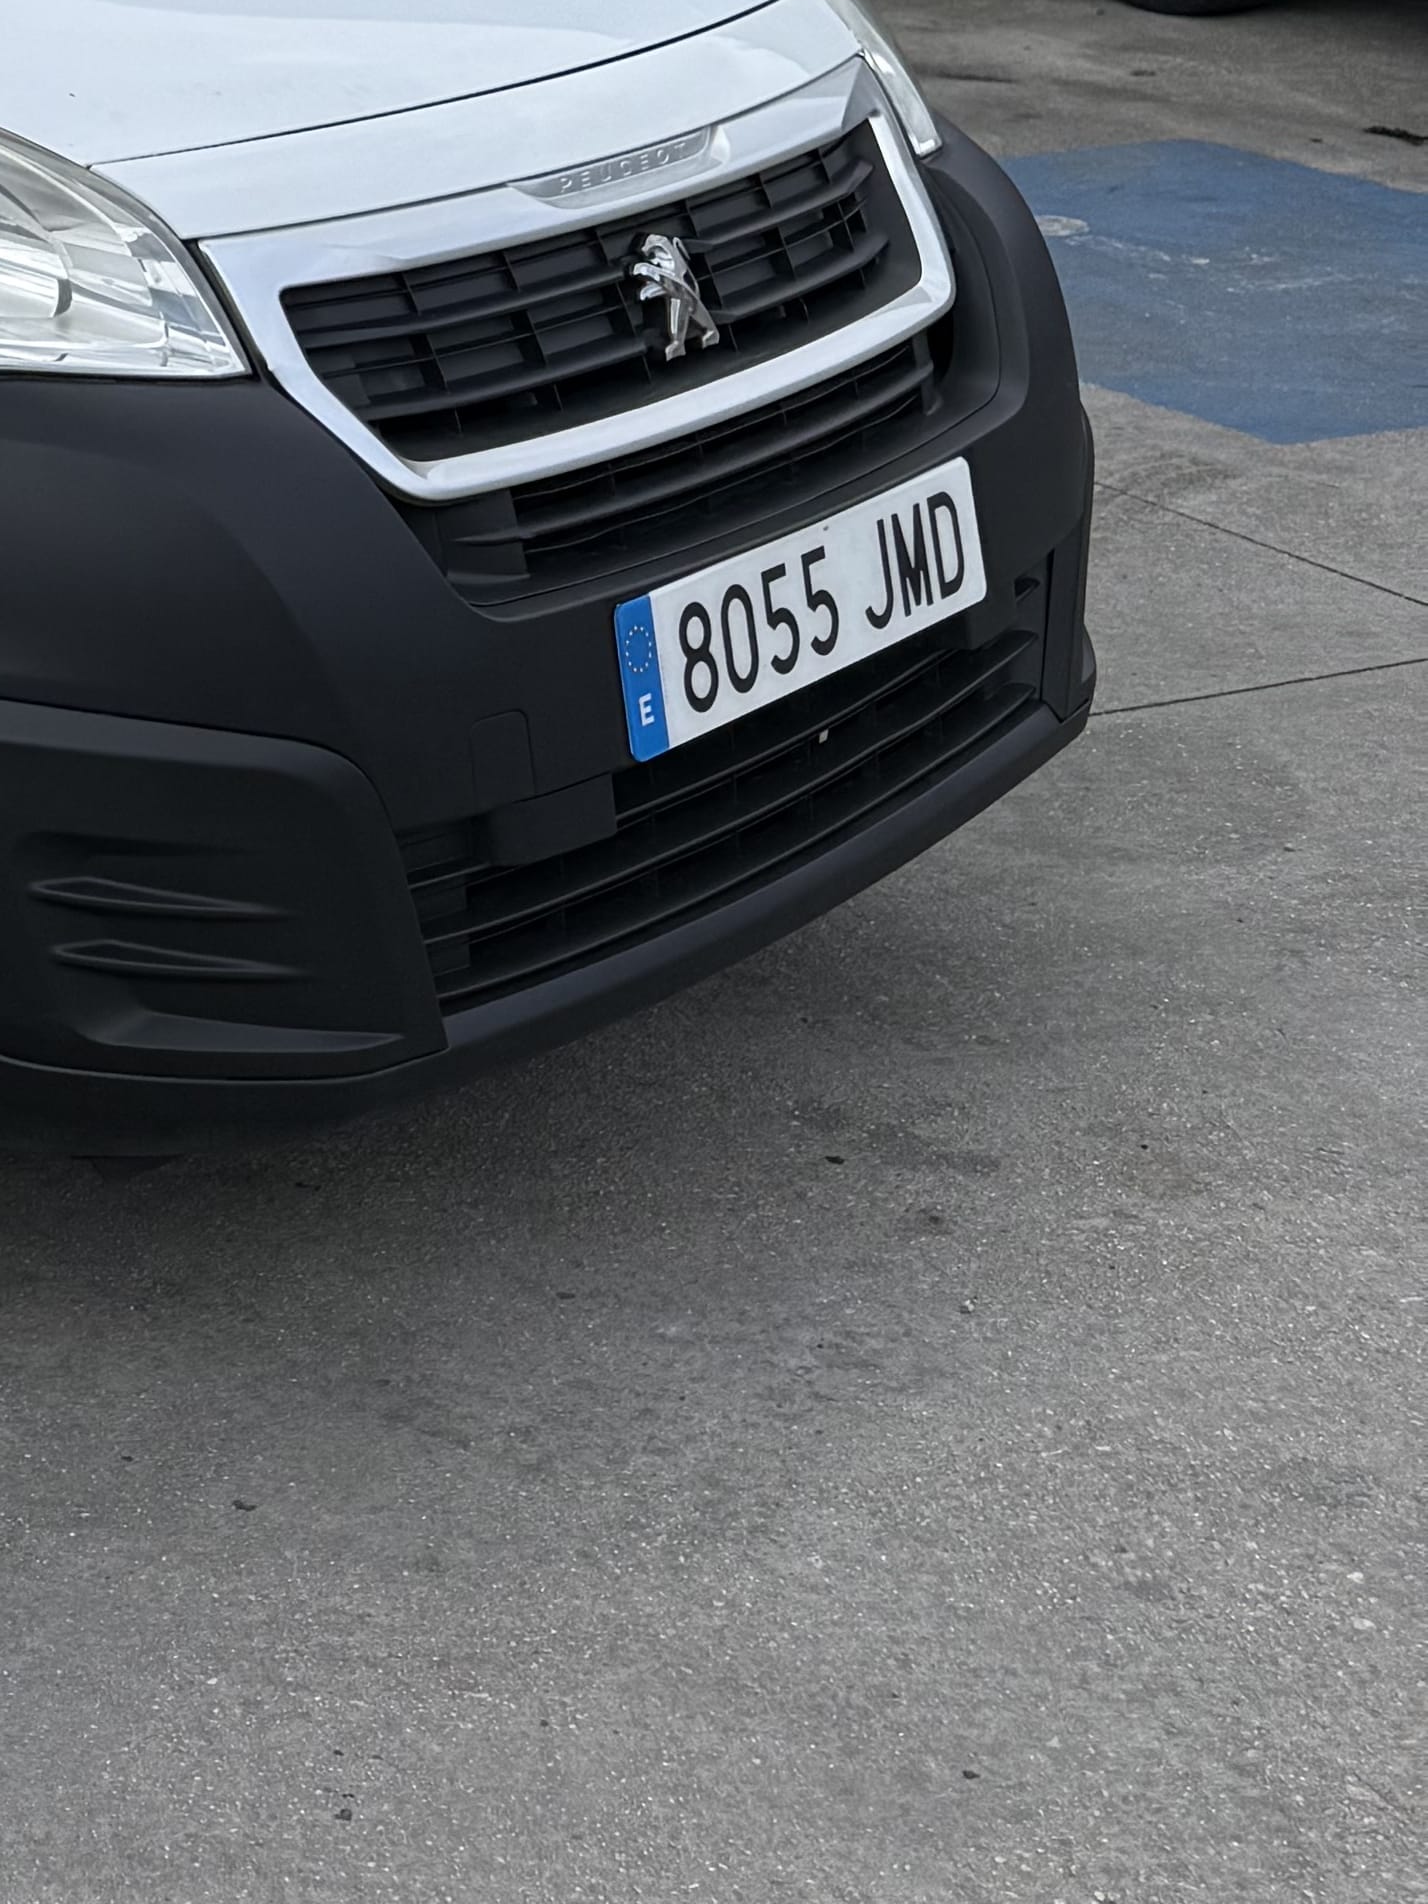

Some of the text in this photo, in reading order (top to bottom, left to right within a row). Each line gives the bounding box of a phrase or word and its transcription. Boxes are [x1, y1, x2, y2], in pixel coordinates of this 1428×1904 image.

[678, 490, 966, 713] 8055 JMD
[638, 693, 656, 727] E
